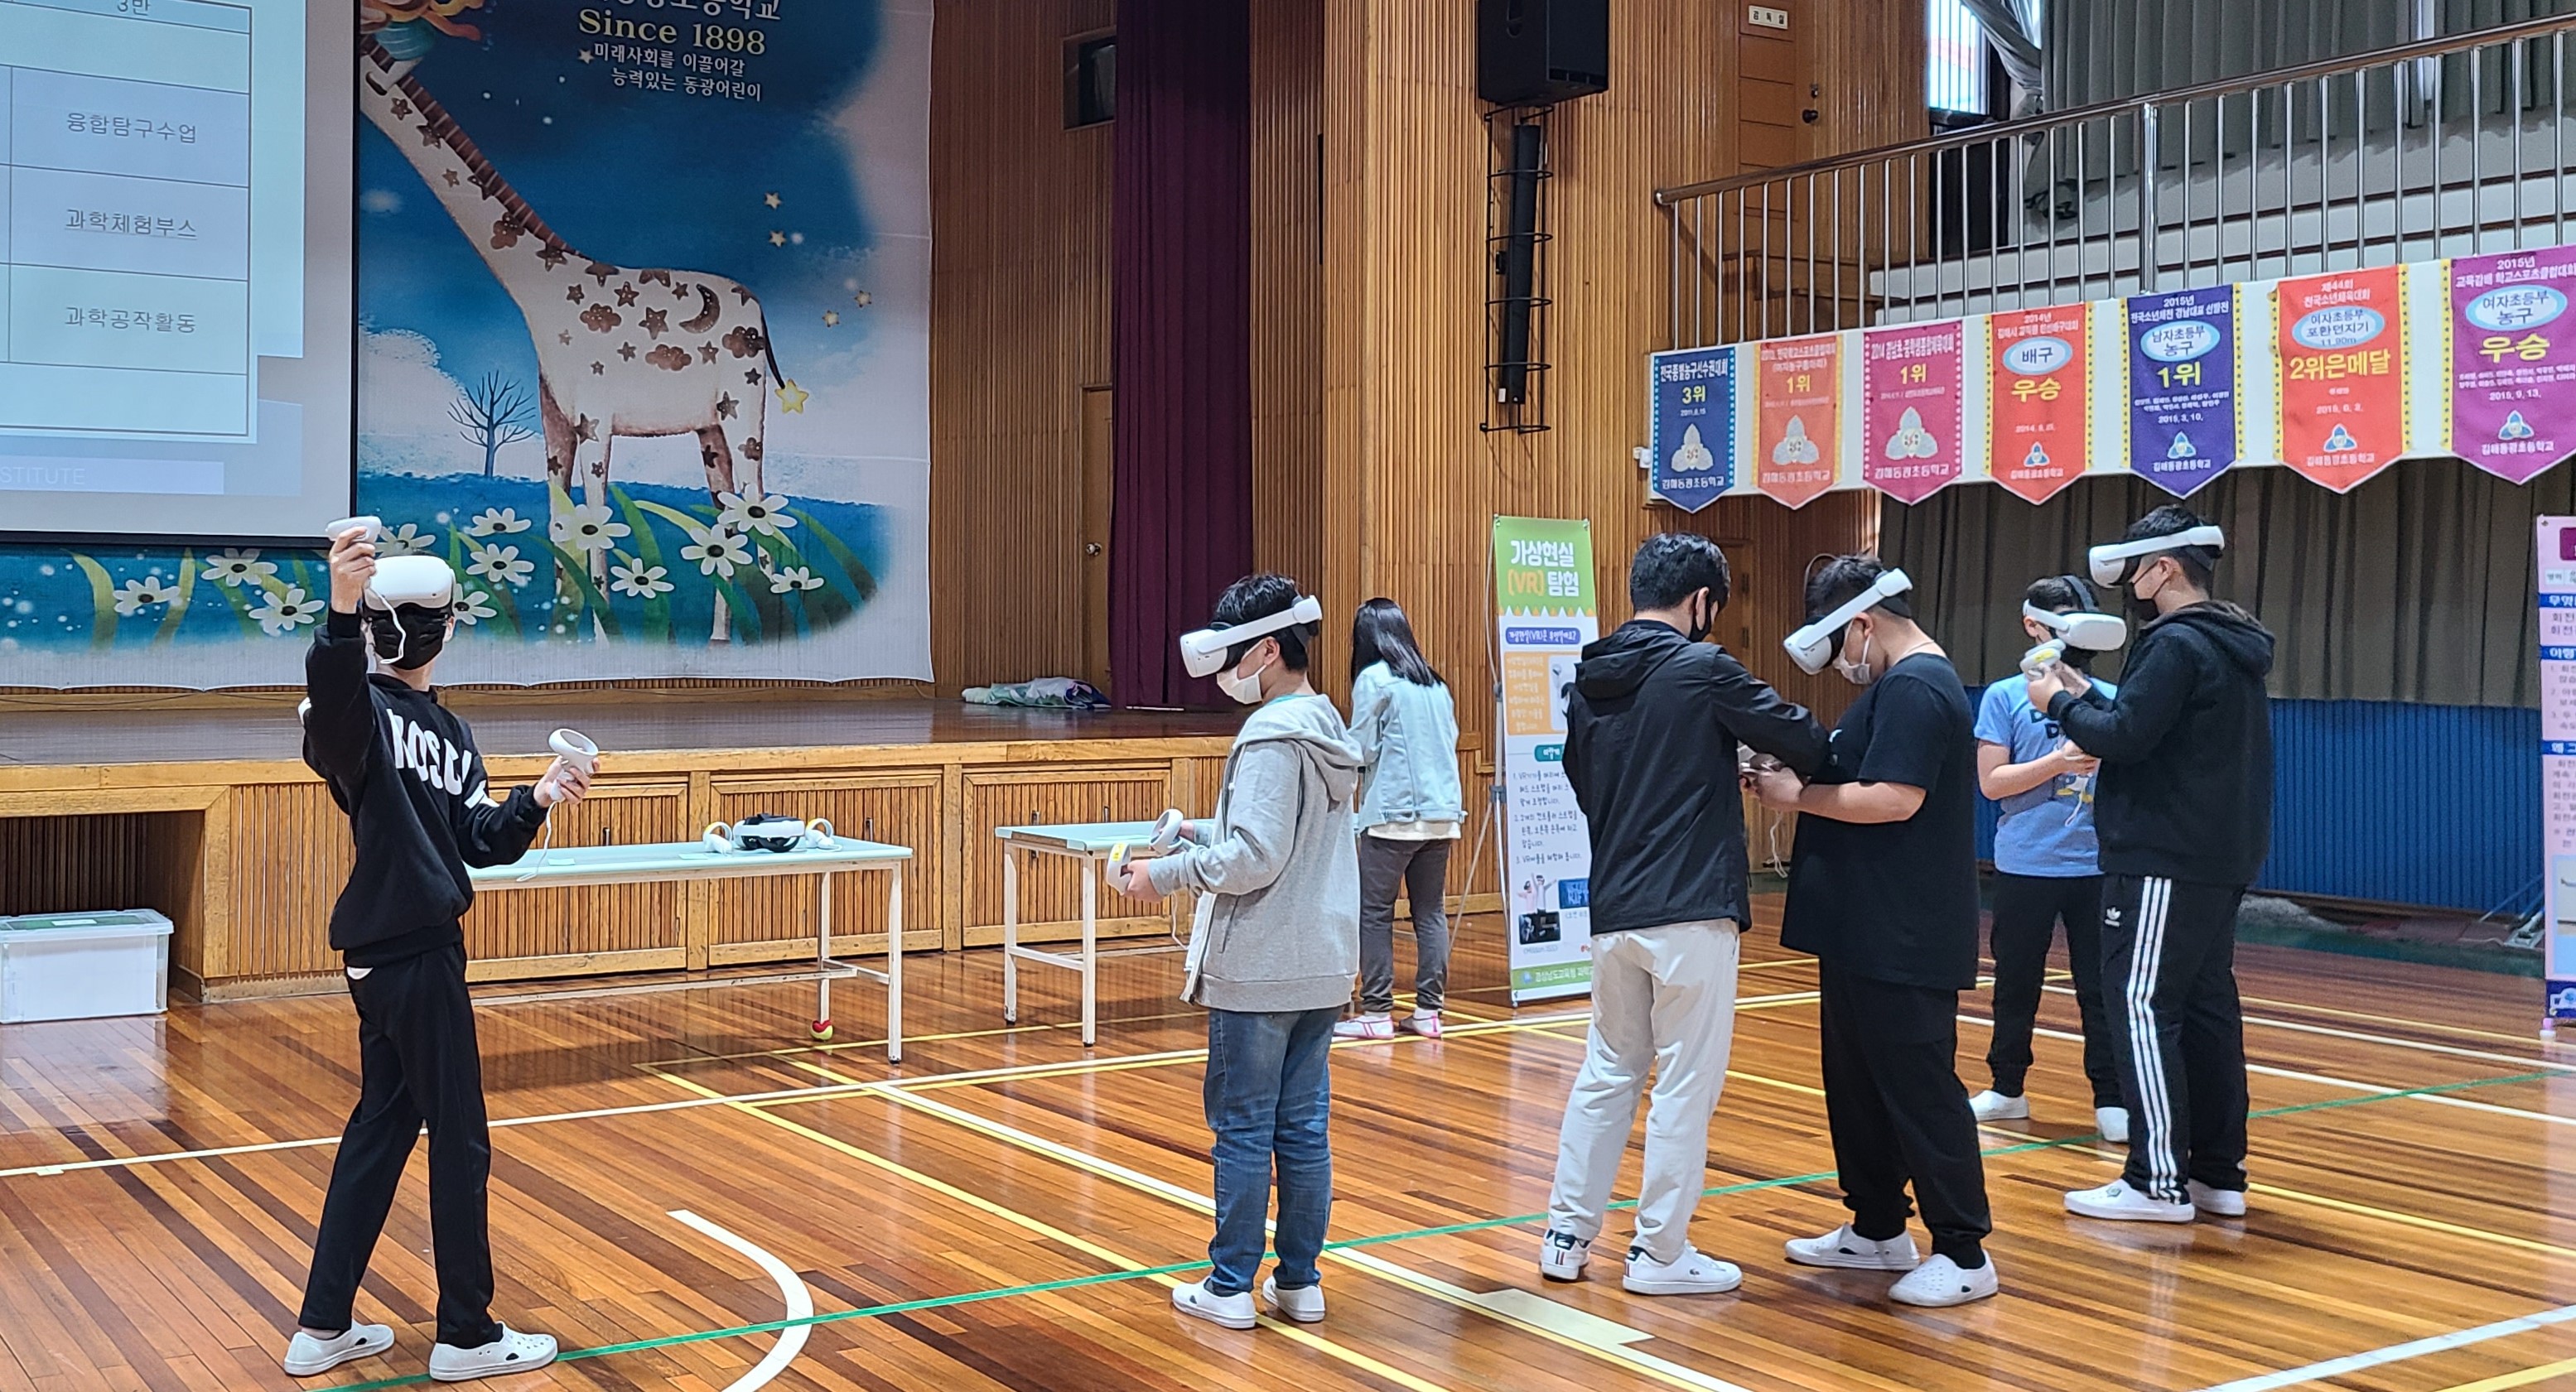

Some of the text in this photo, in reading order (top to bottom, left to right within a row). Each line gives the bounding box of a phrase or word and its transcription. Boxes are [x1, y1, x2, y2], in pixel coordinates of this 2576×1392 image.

[579, 8, 765, 55] Since 1898
[594, 42, 745, 77] 미래사회를 이끌어갈
[611, 67, 761, 102] 능력있는 동광어린이
[67, 113, 195, 143] 융합탐구수업
[65, 209, 197, 238] 과학체험부스
[2497, 256, 2535, 270] 2015년
[2164, 295, 2194, 307] 2015년
[2482, 290, 2549, 309] 여자초등부
[65, 307, 196, 334] 과학공작활동
[2496, 307, 2534, 325] 농구
[2152, 325, 2205, 343] 남자초등부
[2022, 347, 2053, 364] 배구
[2164, 341, 2193, 357] 농구
[2479, 333, 2549, 364] 우승
[1787, 374, 1810, 393] 1위
[1900, 363, 1927, 384] 1위
[2157, 361, 2201, 388] 1위
[1682, 385, 1705, 404] 3위
[2011, 378, 2061, 402] 우승
[1511, 540, 1575, 567] 가상현실
[1547, 571, 1579, 596] 탐험
